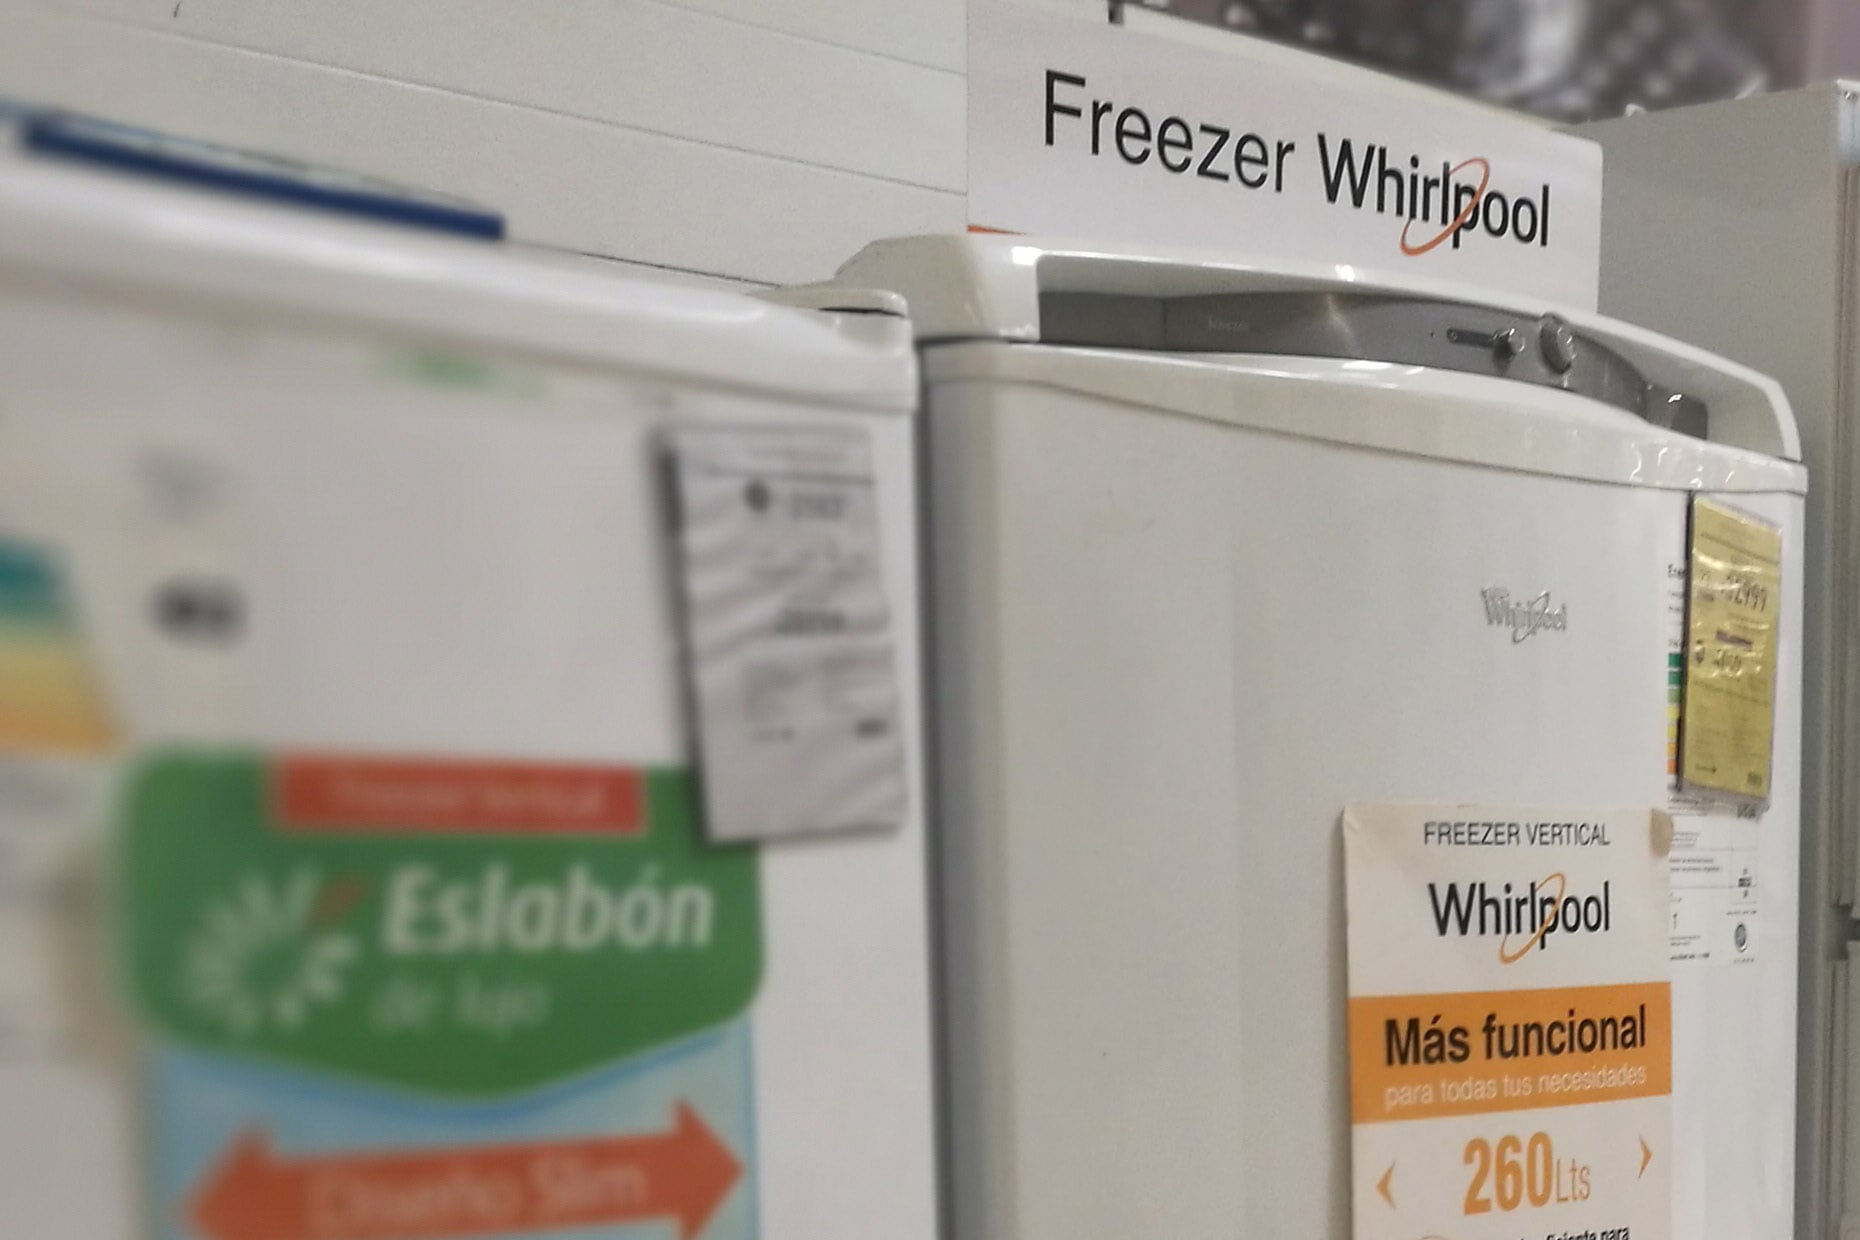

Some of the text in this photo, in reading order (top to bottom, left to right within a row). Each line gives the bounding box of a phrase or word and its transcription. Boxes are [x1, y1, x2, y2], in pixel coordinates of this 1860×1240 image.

[1043, 69, 1551, 250] Freezer Whirlpool
[1481, 588, 1567, 642] Whirlpool
[1424, 821, 1610, 847] FREEZER VERTICAL
[381, 864, 714, 954] Eslabón
[1428, 881, 1610, 950] Whirlpool
[1384, 1004, 1646, 1067] Más funcional
[1384, 1063, 1647, 1111] para todas tus necesidades
[532, 1154, 646, 1214] Slim
